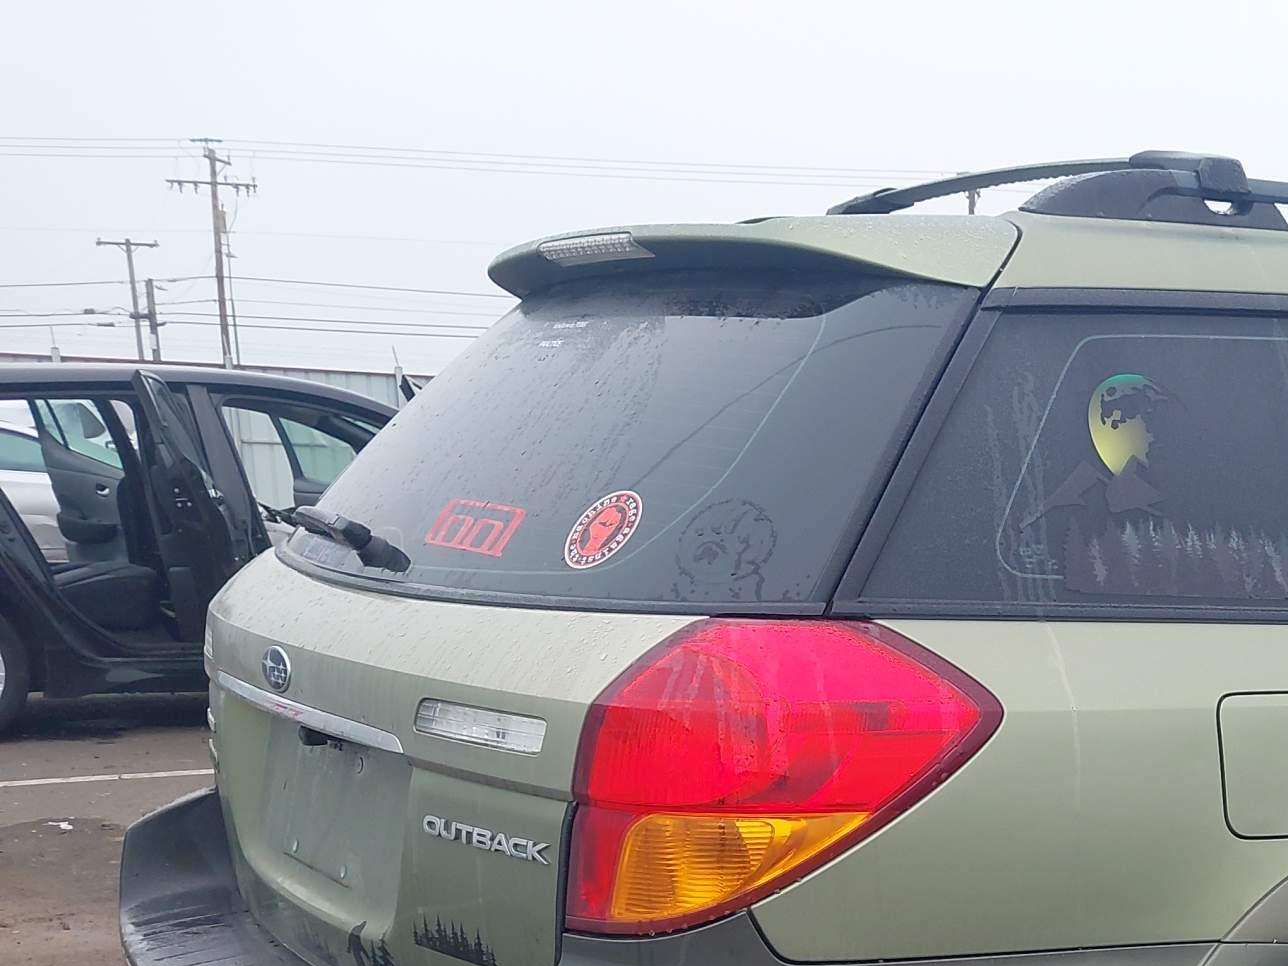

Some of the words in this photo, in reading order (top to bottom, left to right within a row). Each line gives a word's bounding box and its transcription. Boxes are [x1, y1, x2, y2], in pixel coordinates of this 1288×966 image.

[625, 497, 637, 522] rage
[580, 526, 631, 565] against
[422, 814, 552, 865] OUTBACK
